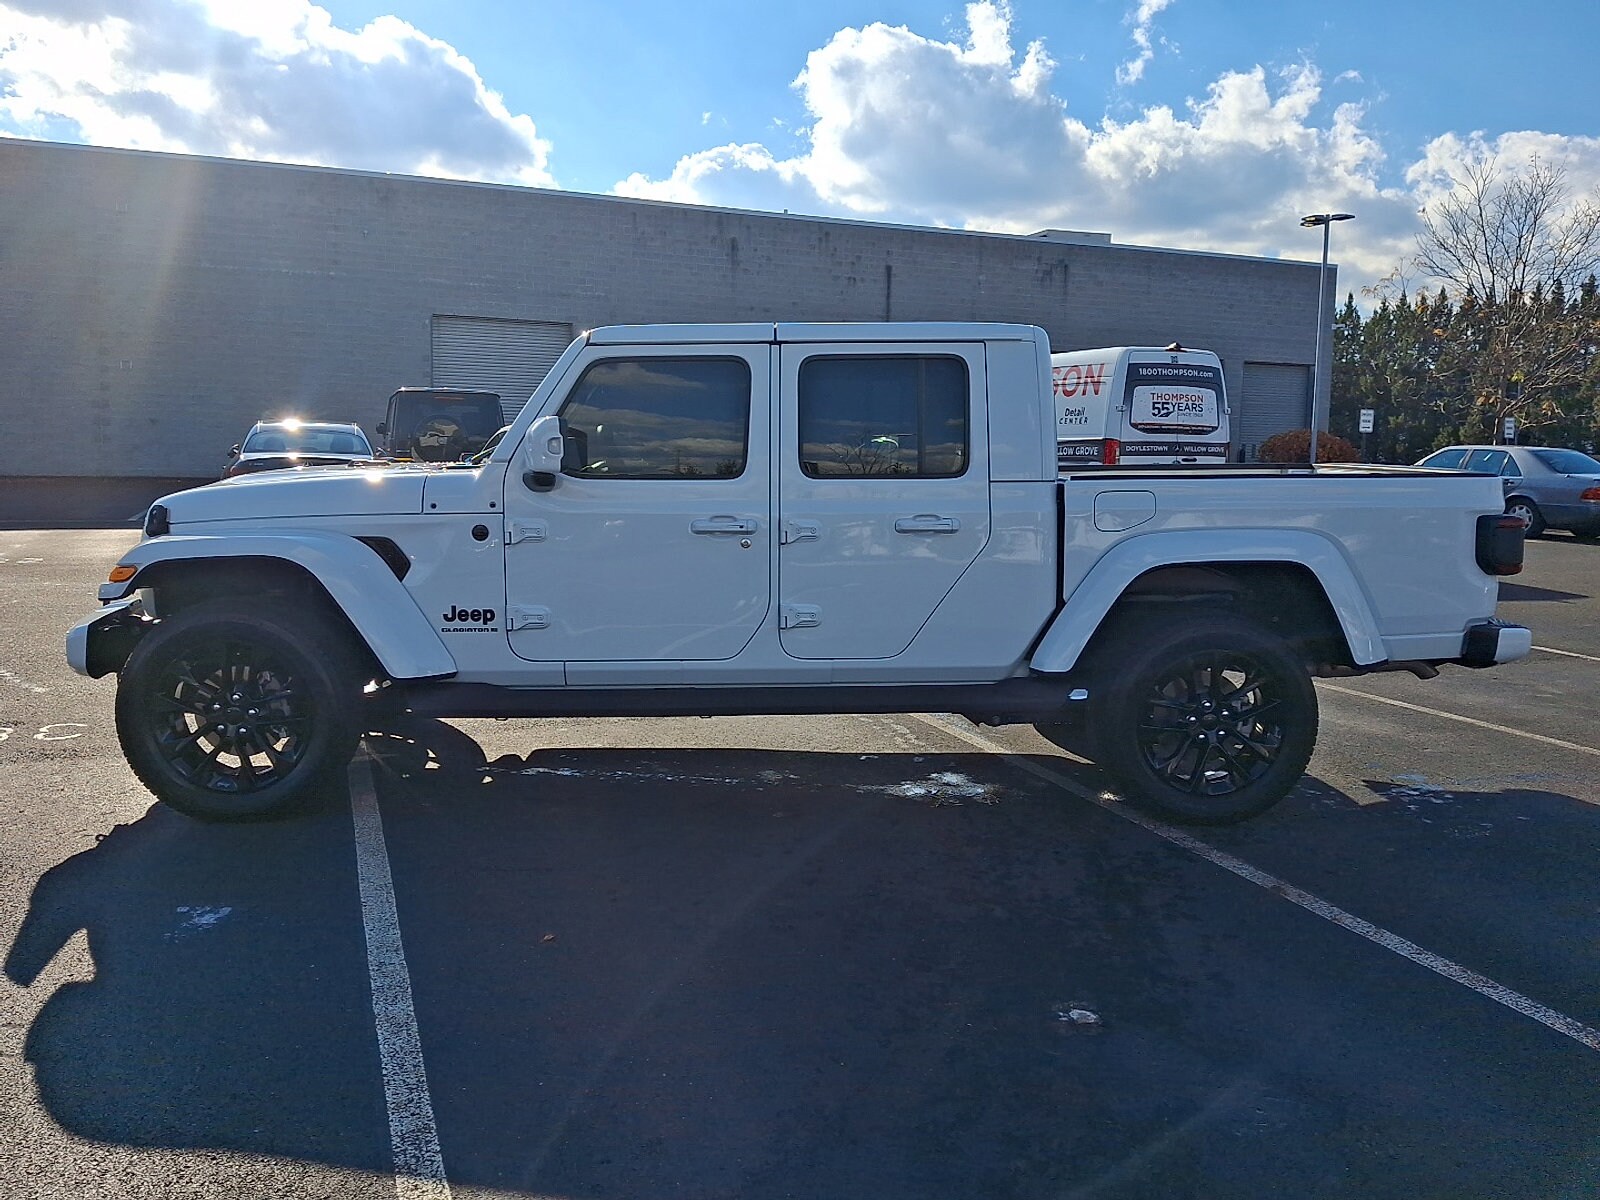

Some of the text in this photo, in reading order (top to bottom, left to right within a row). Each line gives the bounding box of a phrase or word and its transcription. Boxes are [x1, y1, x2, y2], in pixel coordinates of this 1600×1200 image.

[1138, 367, 1214, 378] 1800THOMPSON.com
[1150, 392, 1204, 402] THOMPSON
[1064, 406, 1086, 417] Detail
[1151, 402, 1204, 417] 55 YEARS
[1075, 446, 1099, 455] GROVE
[442, 605, 496, 626] Jeep
